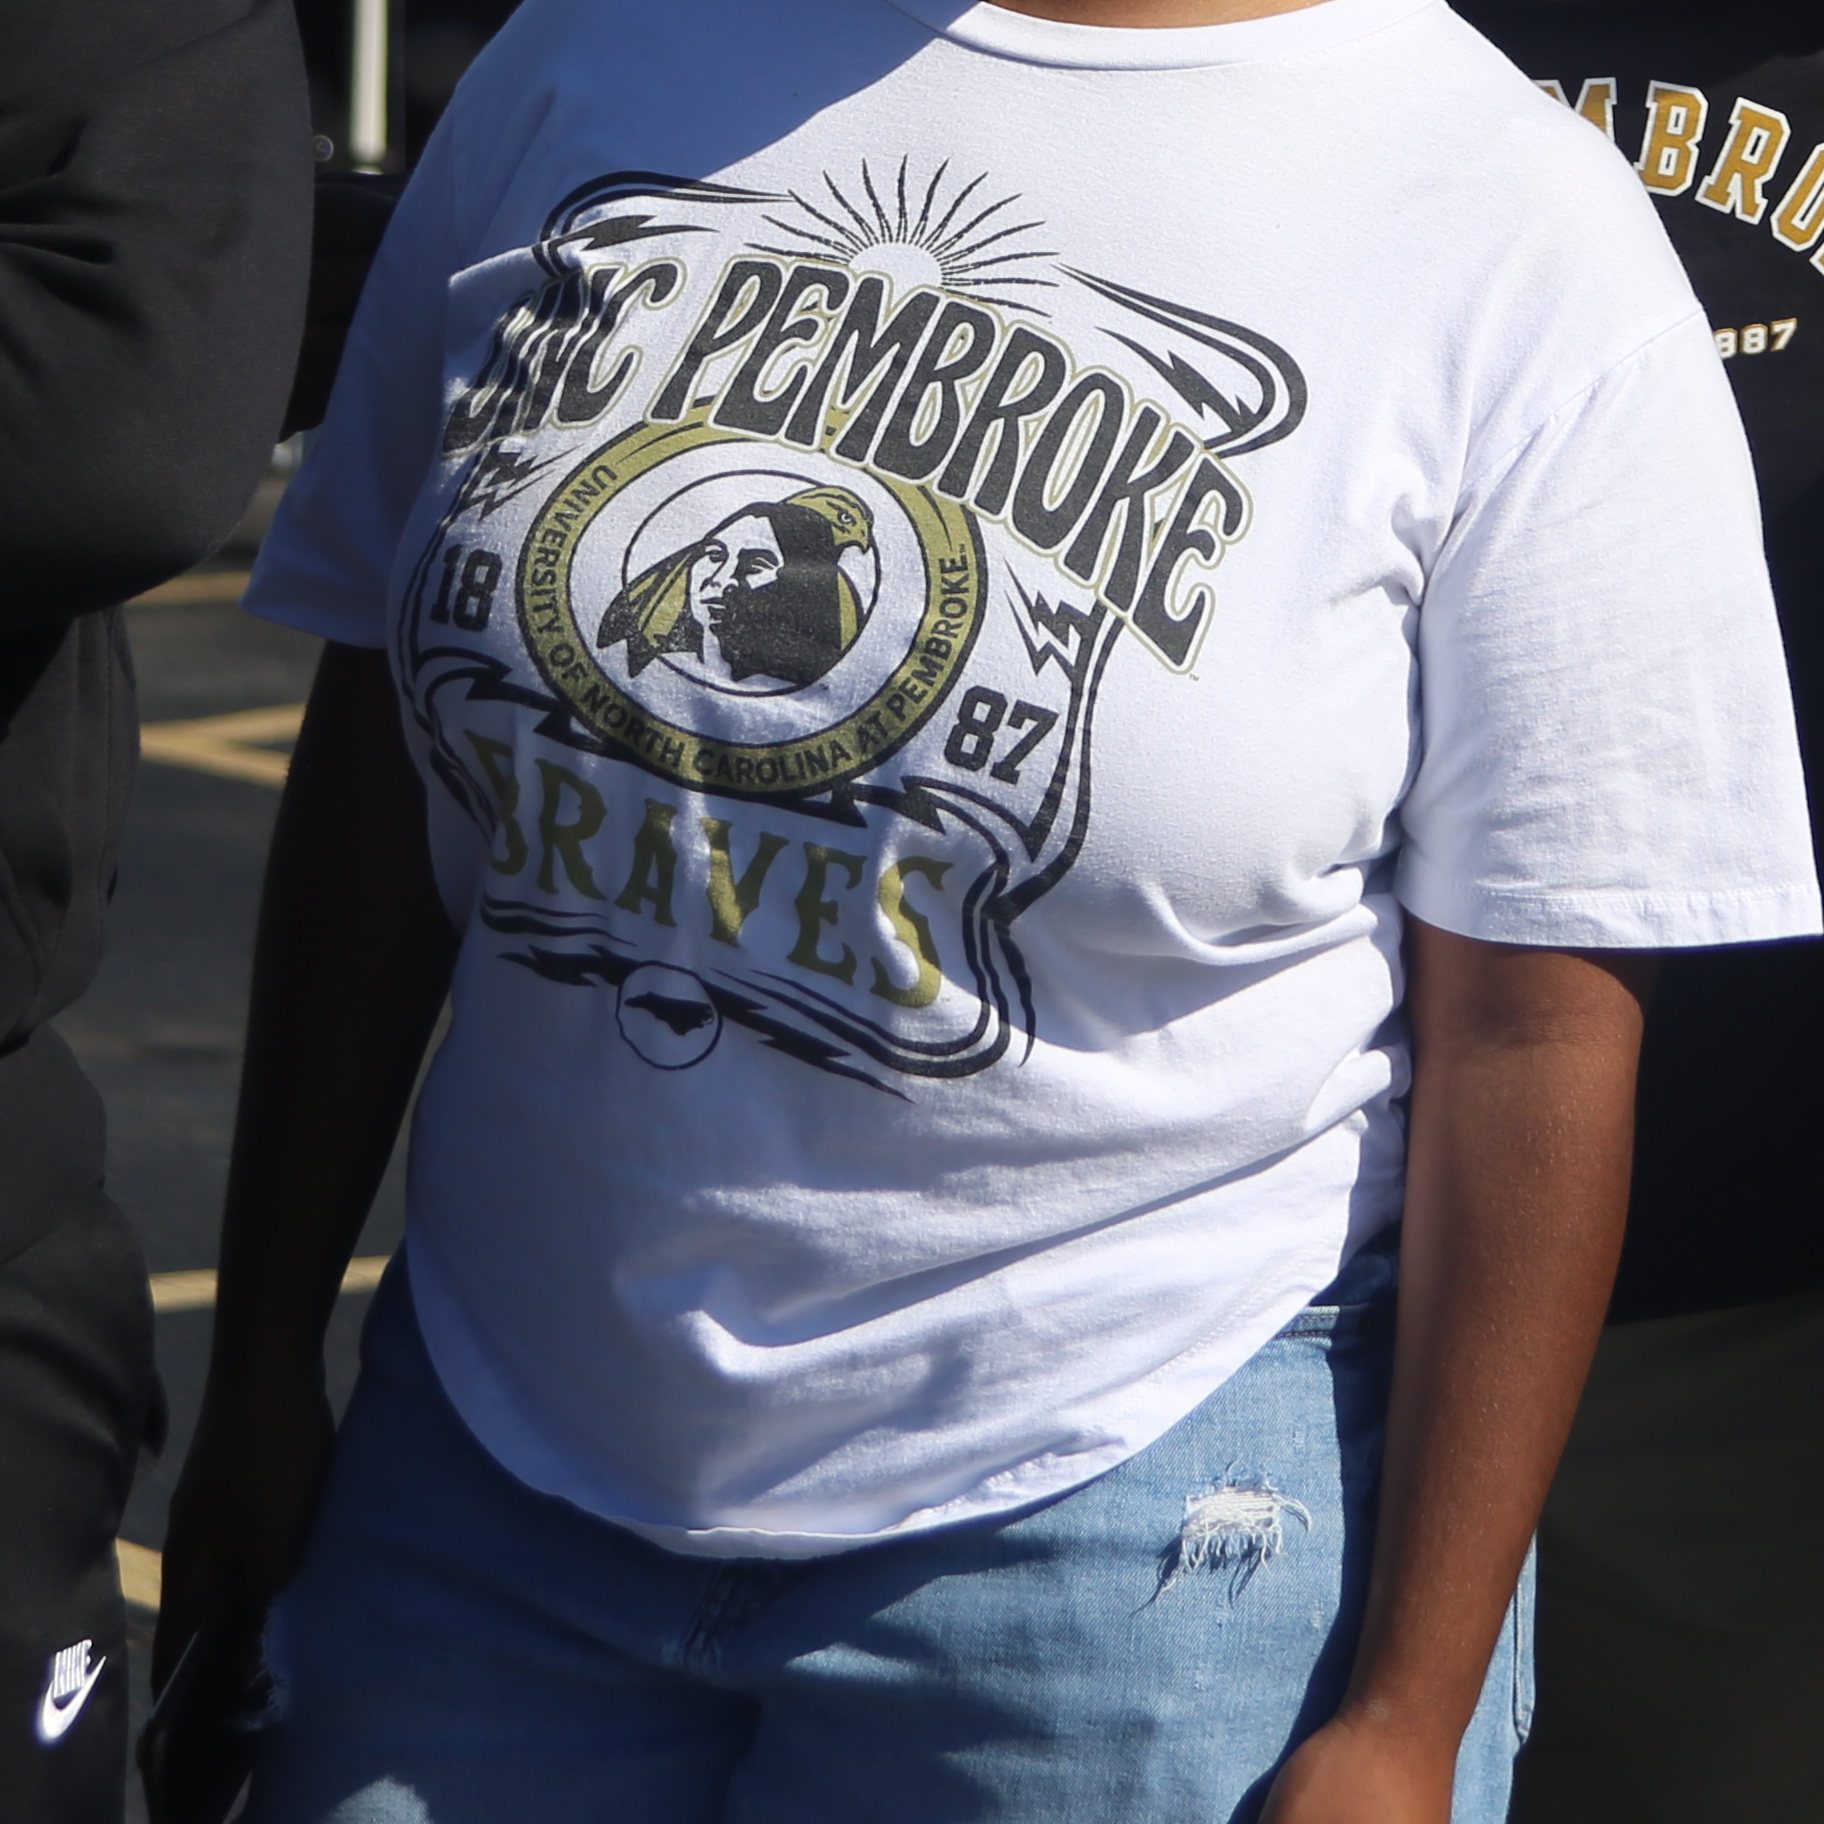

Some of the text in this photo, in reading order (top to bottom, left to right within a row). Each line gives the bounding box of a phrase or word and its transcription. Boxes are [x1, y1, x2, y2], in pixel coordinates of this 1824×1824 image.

[440, 257, 687, 459] UNC
[643, 253, 1252, 675] PEMBROKE
[429, 543, 503, 633] 18
[523, 462, 619, 636] UNIVERSITY
[547, 643, 590, 683] OF
[884, 555, 972, 722] PEMBROKE
[578, 683, 688, 769] NORTH
[690, 737, 853, 786] CAROLINA
[854, 712, 891, 756] AT
[943, 684, 1060, 785] 87
[462, 728, 956, 1009] BRAVES
